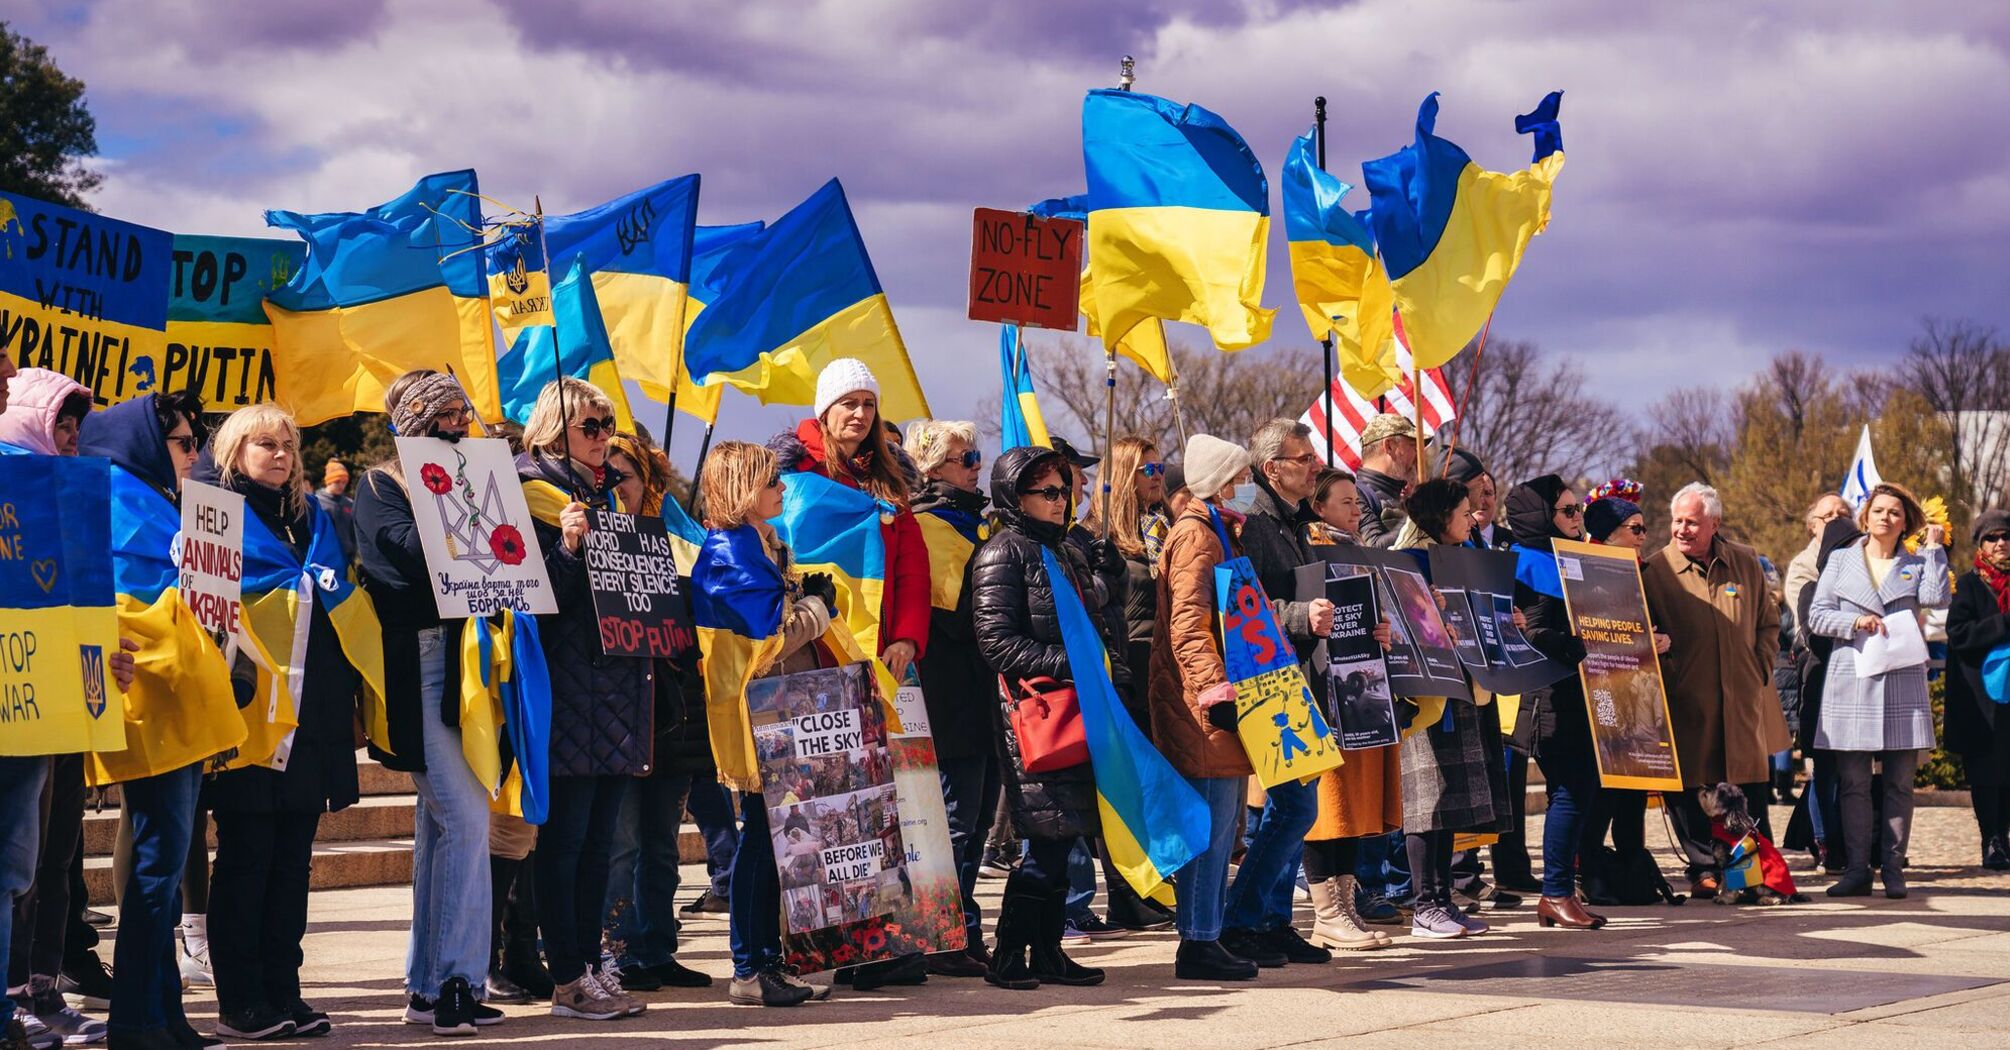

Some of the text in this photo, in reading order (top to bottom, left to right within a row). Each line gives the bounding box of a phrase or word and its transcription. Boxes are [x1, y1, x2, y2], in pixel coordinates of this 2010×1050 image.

[26, 212, 142, 282] STAND
[981, 219, 1072, 261] NO-FLY
[172, 251, 247, 306] TOP
[977, 267, 1053, 311] ZONE
[36, 278, 104, 322] WITH
[195, 503, 230, 537] HELP
[596, 510, 637, 534] EVERY
[583, 528, 671, 556] WORD HAS
[181, 537, 242, 583] ANIMALS
[180, 572, 195, 589] OF
[438, 572, 480, 597] Україна
[590, 570, 680, 596] EVERY SILENCE
[623, 591, 653, 613] TOO
[1333, 603, 1364, 615] OTECT
[1333, 611, 1363, 622] HE SKY
[1333, 621, 1358, 631] OVER
[1578, 616, 1645, 633] HELPING PEOPLE.
[601, 615, 694, 656] STOP PUTIN
[1329, 627, 1367, 639] UKRAINE
[1581, 629, 1634, 645] SAVING LIVES.
[0, 630, 37, 673] TOP
[792, 711, 851, 733] "CLOSE
[798, 731, 861, 755] THE SKY
[824, 842, 882, 865] BEFORE WE
[828, 866, 851, 883] ALL
[852, 862, 871, 879] DIE"
